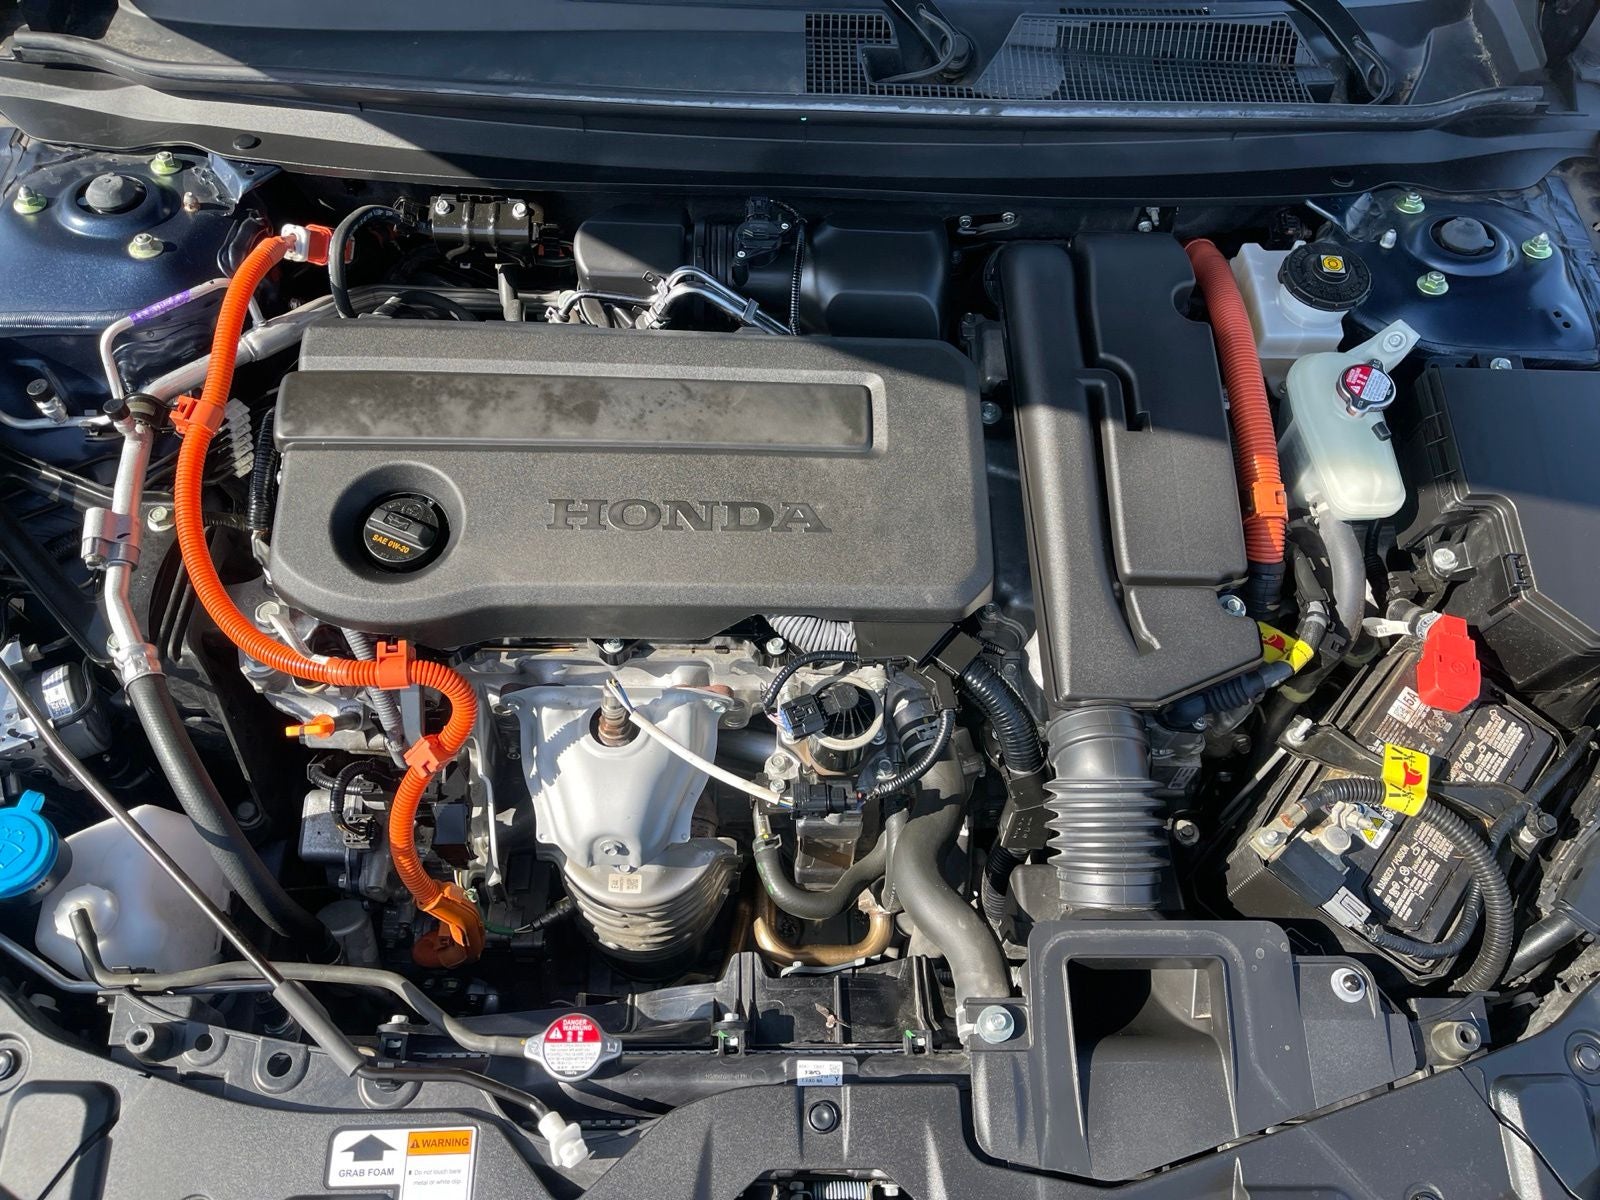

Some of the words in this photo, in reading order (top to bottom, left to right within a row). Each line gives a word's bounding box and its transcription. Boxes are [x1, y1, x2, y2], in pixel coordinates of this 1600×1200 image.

[547, 499, 832, 533] HONDA
[372, 534, 389, 545] SAE
[387, 540, 410, 554] 0W-20
[1459, 740, 1476, 760] POISON
[1376, 866, 1395, 889] DANGER
[1392, 843, 1410, 865] POISON
[422, 1138, 469, 1148] WARNING
[338, 1168, 365, 1178] GRAB
[367, 1167, 395, 1177] FOAM
